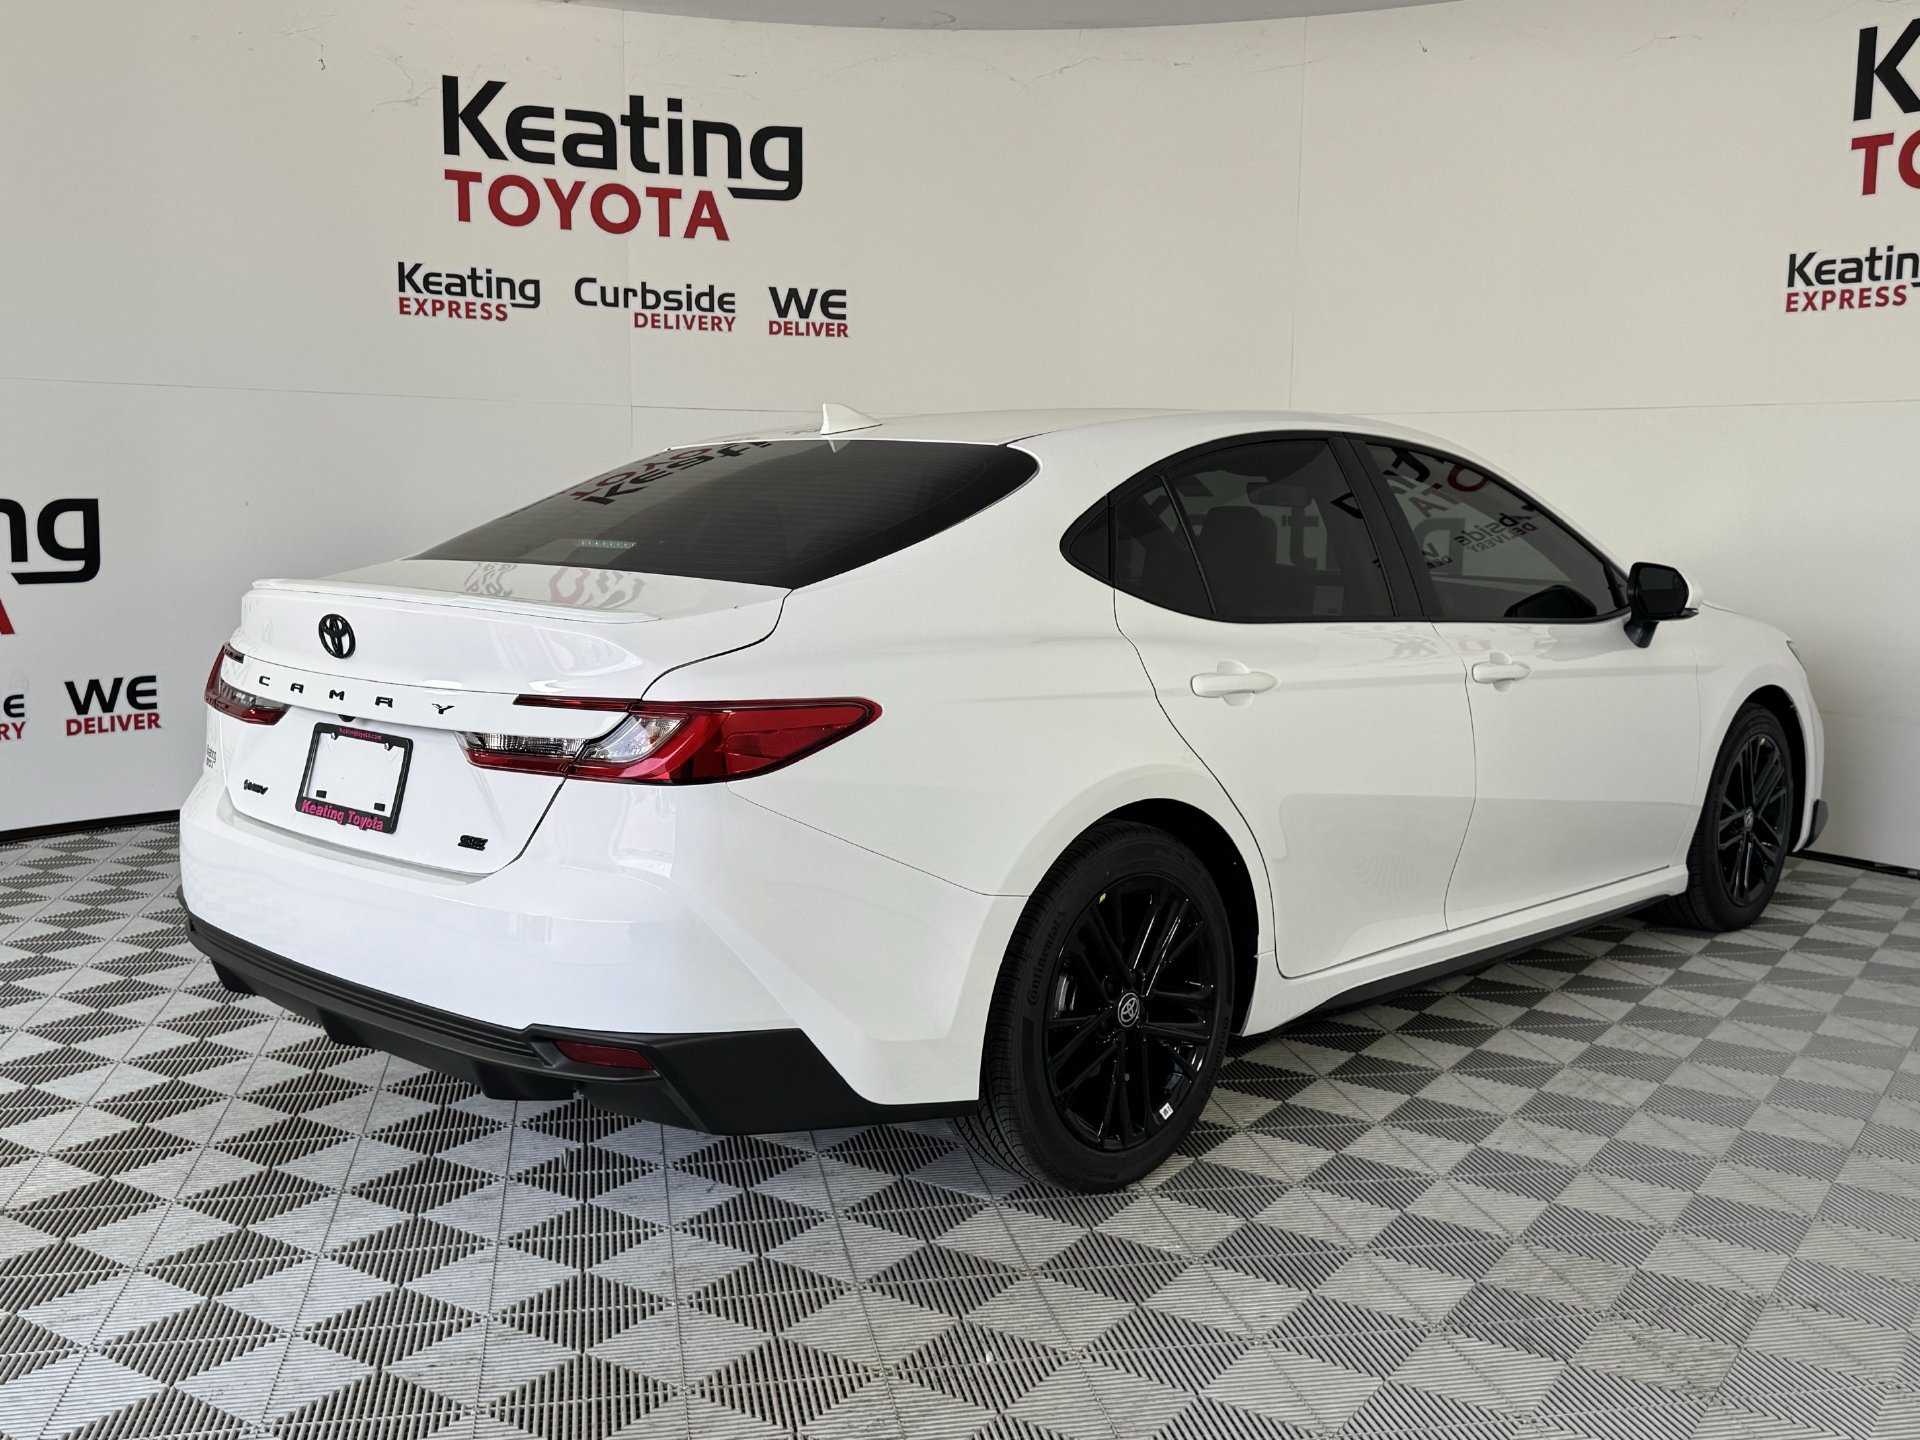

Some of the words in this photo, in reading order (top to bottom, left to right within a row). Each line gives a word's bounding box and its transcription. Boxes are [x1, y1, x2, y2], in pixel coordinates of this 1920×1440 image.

[441, 74, 803, 202] Keating
[444, 169, 730, 242] TOYOTA
[397, 261, 541, 309] Keating
[1786, 245, 1920, 290] Keatin
[398, 296, 509, 322] EXPRESS
[574, 277, 736, 314] Curbside
[768, 286, 847, 321] WE
[1785, 284, 1908, 313] EXPRESS
[633, 311, 737, 333] DELIVERY
[768, 320, 849, 338] DELIVER
[64, 674, 158, 716] WE
[258, 675, 455, 715] CAMRY
[66, 712, 161, 737] DELIVER
[301, 799, 345, 824] Keating
[348, 810, 385, 831] Toyota
[1027, 917, 1061, 1006] Continental
